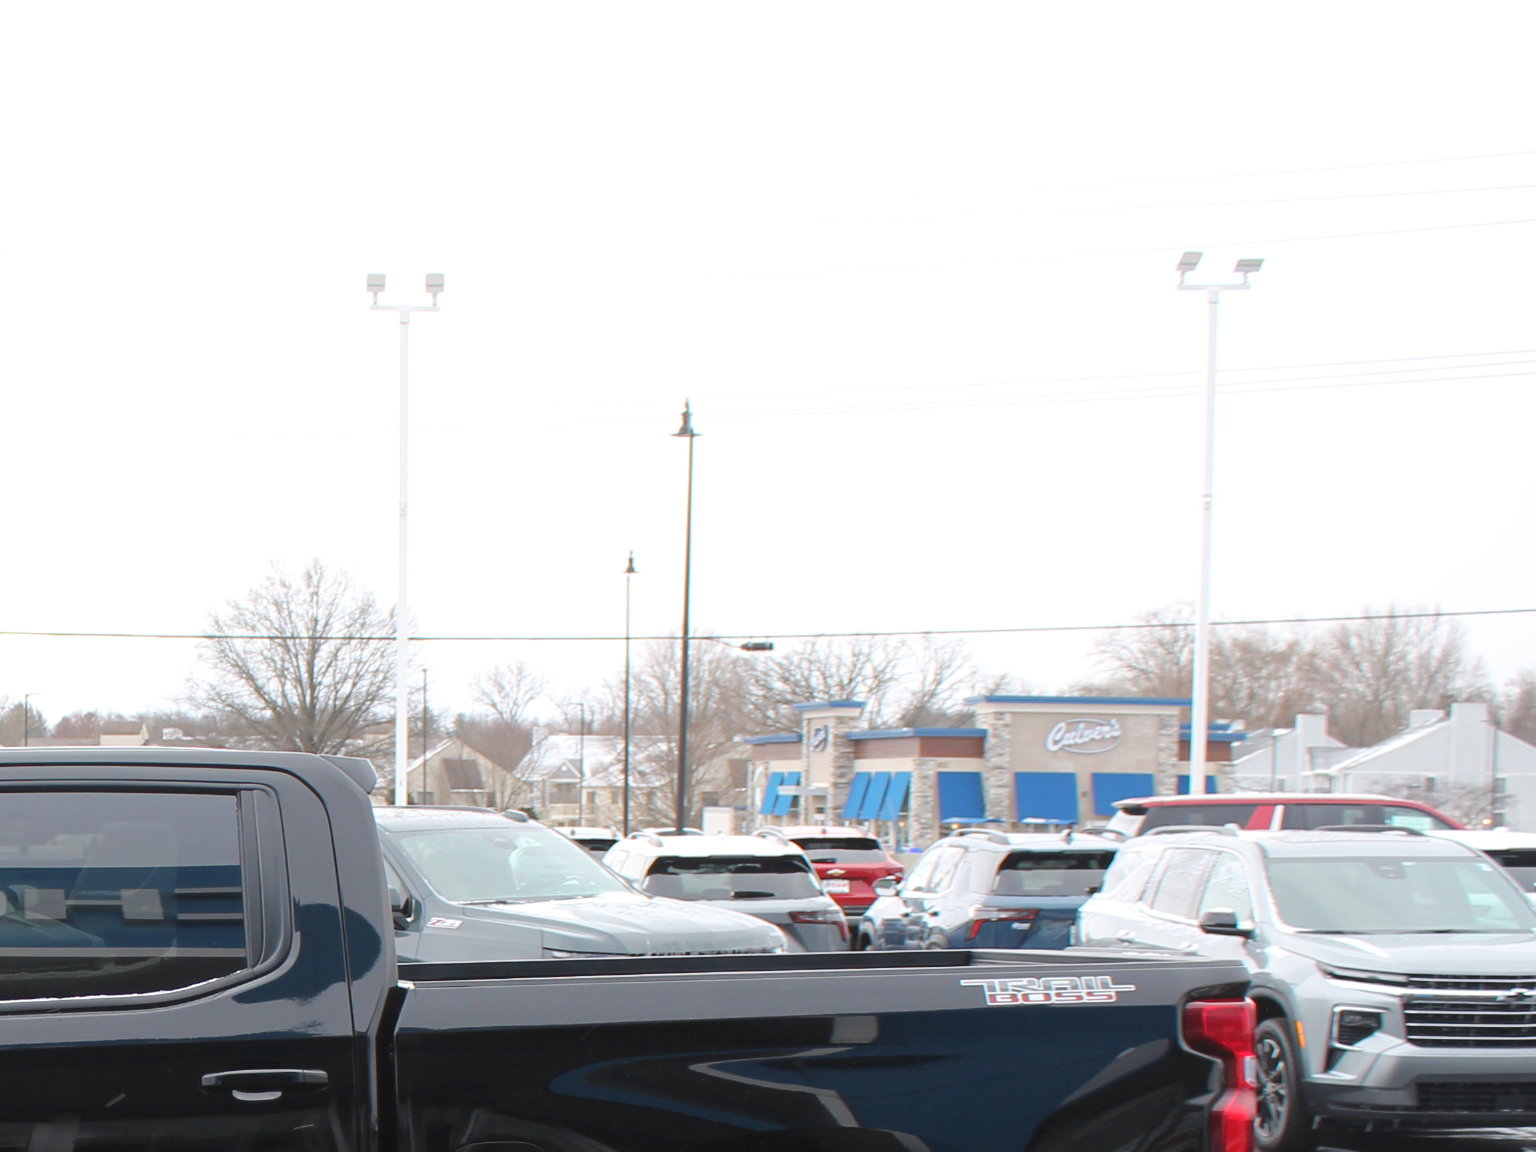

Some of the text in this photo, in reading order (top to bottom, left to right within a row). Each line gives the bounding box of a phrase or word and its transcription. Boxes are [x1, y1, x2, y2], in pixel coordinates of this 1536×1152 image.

[1046, 718, 1122, 752] Culver's
[960, 975, 1137, 994] TRAIL
[985, 991, 1117, 1006] BOSS
